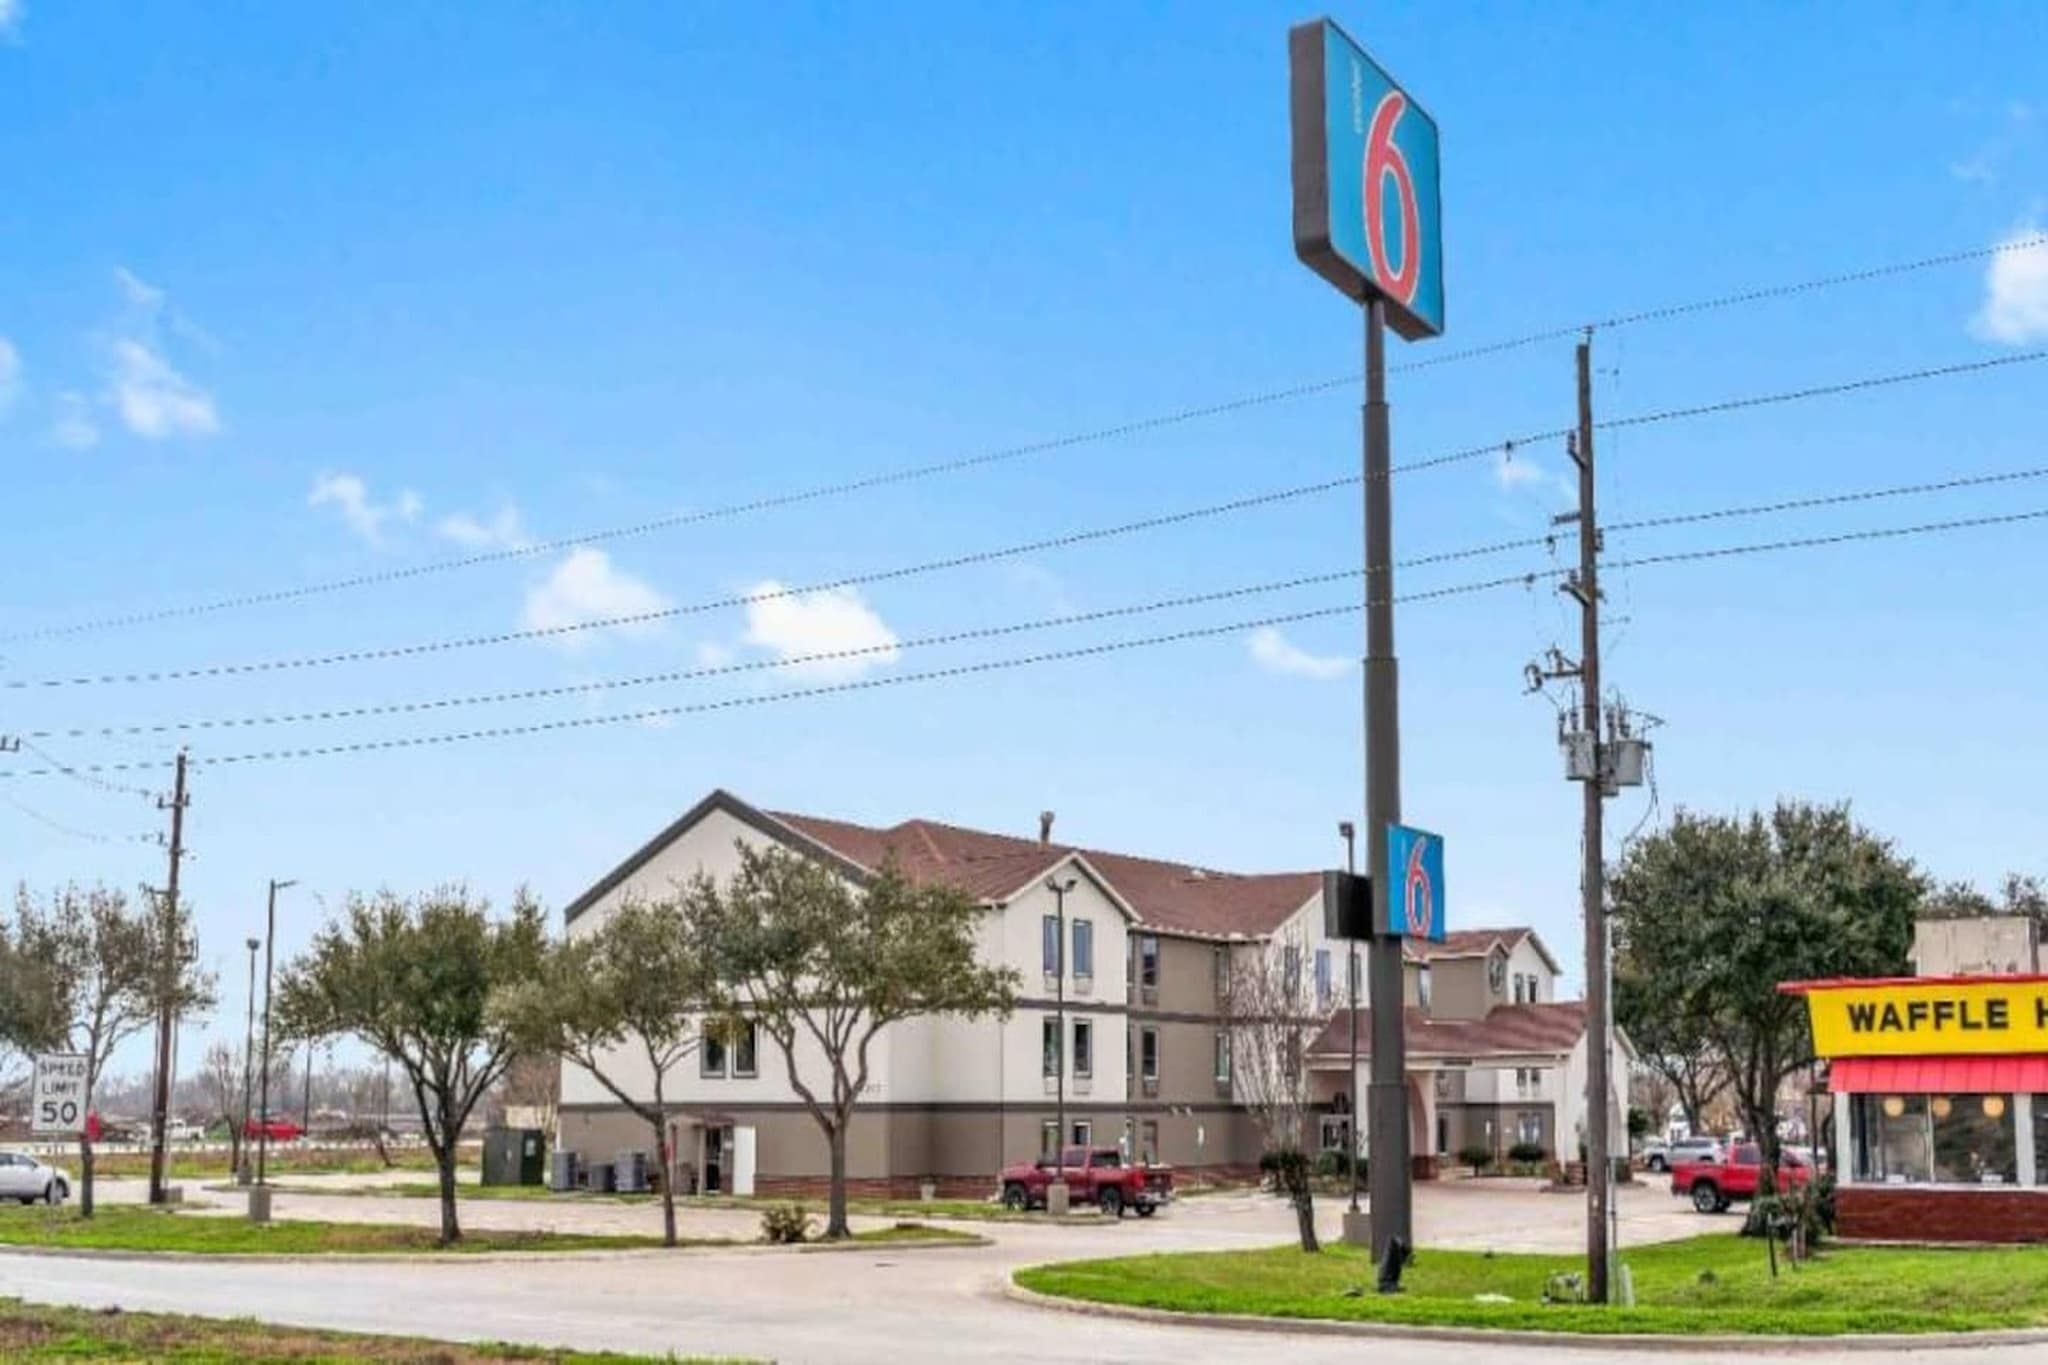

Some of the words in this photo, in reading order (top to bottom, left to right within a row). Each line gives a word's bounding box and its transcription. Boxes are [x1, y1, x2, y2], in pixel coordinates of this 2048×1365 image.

[1363, 91, 1420, 305] 6
[1405, 836, 1432, 938] 6
[1847, 998, 2009, 1033] WAFFLE
[40, 1062, 85, 1076] SPEED
[42, 1082, 77, 1095] LIMIT
[42, 1101, 77, 1124] 50
